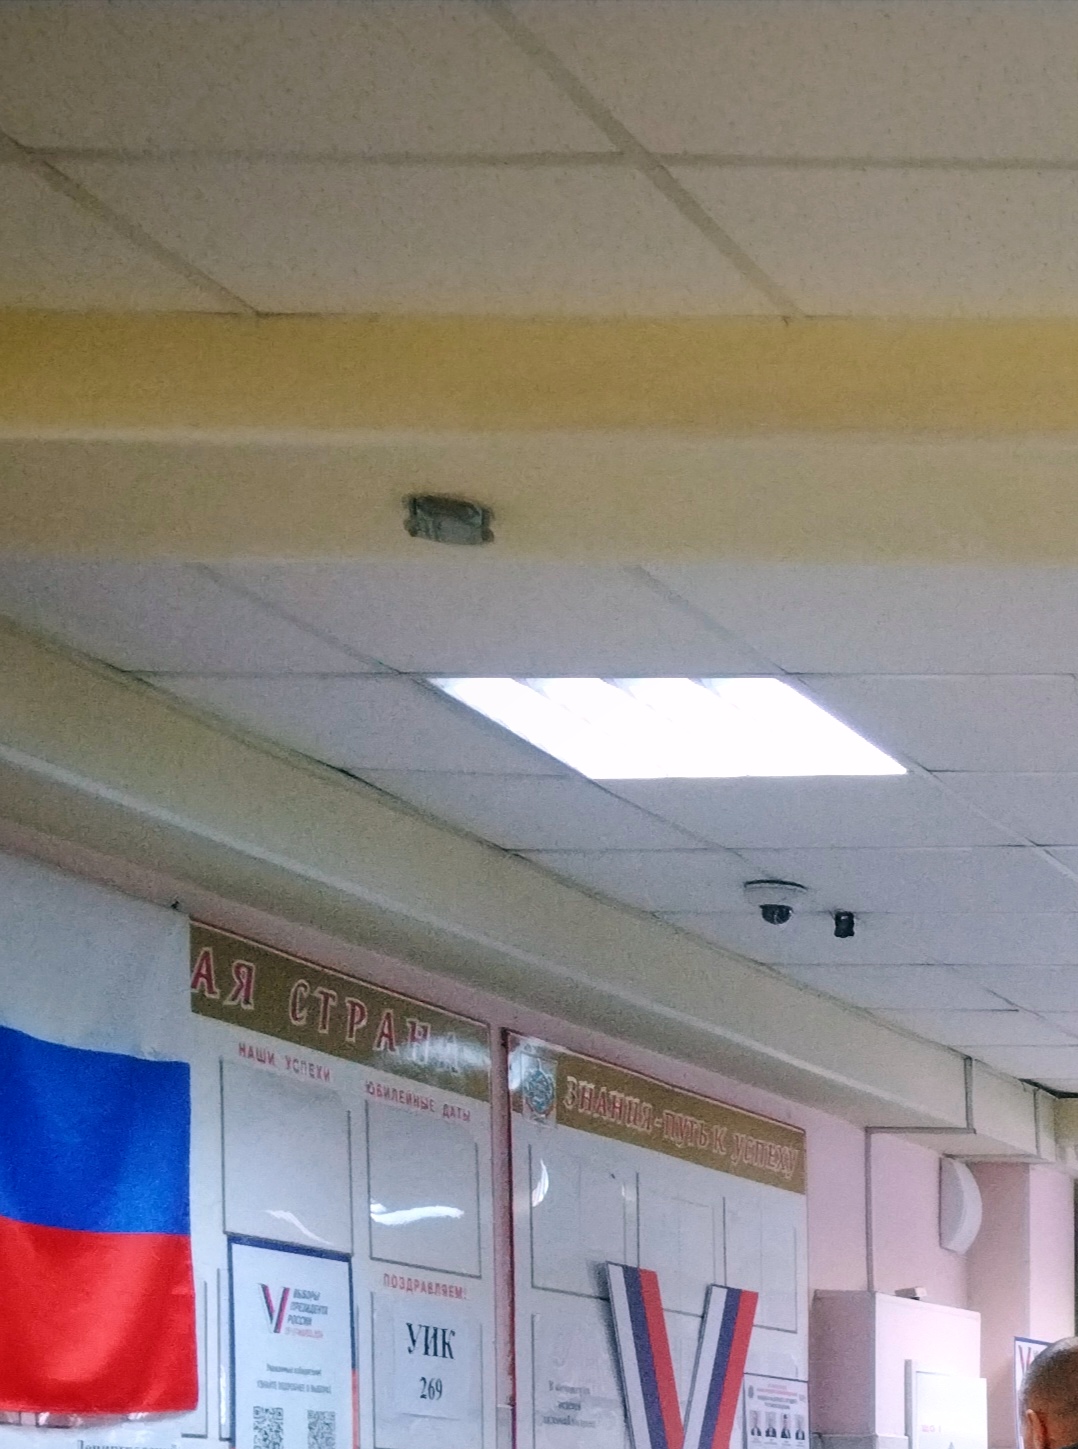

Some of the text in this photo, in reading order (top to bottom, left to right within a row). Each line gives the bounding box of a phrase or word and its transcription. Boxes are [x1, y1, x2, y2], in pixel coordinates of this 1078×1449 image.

[238, 1042, 331, 1081] НАШИ УСПЕХИ
[365, 1080, 471, 1123] ЮБИЛЕЙНЫЕ ДАТЫ
[712, 1124, 728, 1155] К
[383, 1273, 467, 1299] ПОЗДРАВЛЯЕМ!
[405, 1322, 456, 1360] УИК
[419, 1376, 443, 1401] 269
